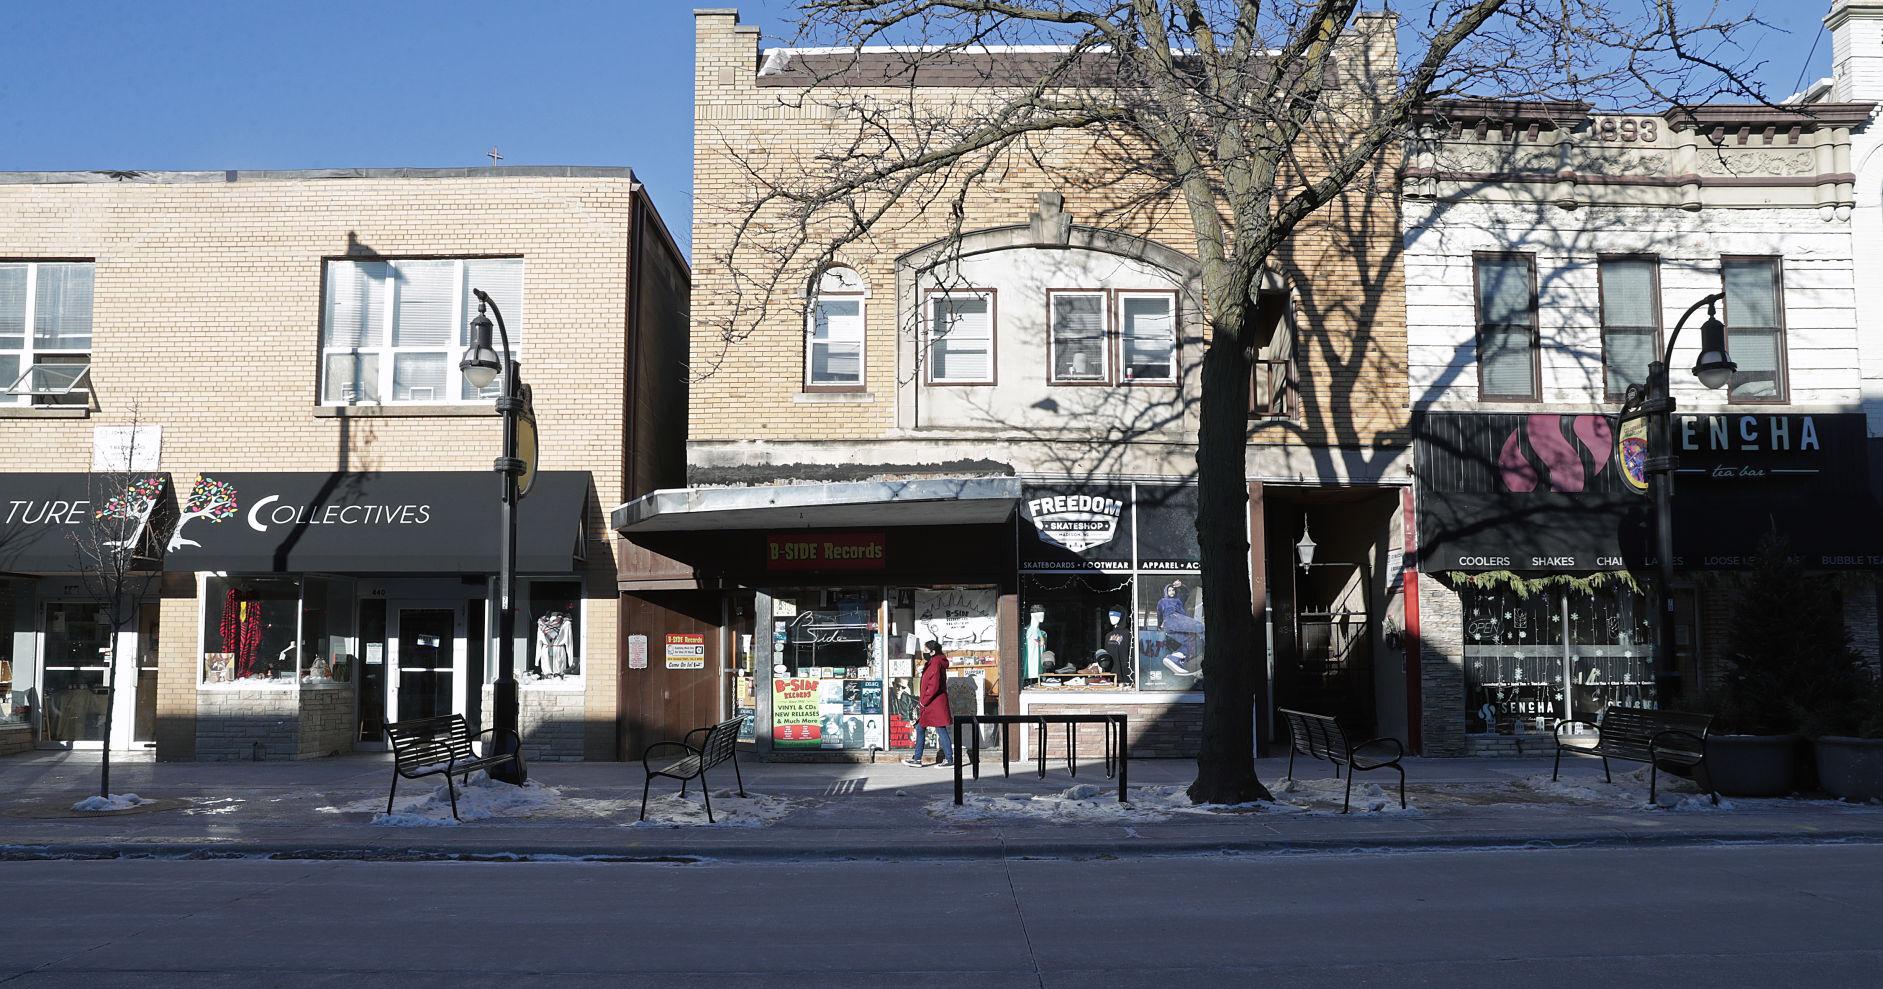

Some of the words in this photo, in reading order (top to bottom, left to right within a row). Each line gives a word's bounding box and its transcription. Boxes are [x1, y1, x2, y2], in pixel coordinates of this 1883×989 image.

[1681, 415, 1821, 451] ENCHA
[1711, 464, 1737, 478] tea
[1739, 463, 1767, 478] bar
[5, 500, 90, 524] TURE
[247, 494, 430, 532] COLLECTIVES
[1028, 495, 1123, 517] FREEDOM
[1050, 522, 1104, 530] SKATESHOP
[770, 542, 818, 560] B-SIDE
[823, 542, 883, 560] Records
[1459, 556, 1510, 566] COOLERS
[1532, 556, 1575, 566] SHAKES
[1596, 556, 1623, 566] CHAI
[1644, 556, 1684, 566] LAES
[1704, 556, 1741, 565] LOOSE
[1822, 555, 1864, 565] BUBBLE
[1866, 555, 1883, 565] TE
[1468, 622, 1500, 634] OPEN
[775, 679, 820, 693] B-SIDE
[784, 691, 812, 699] RECORDS
[1501, 701, 1554, 714] SENCHA
